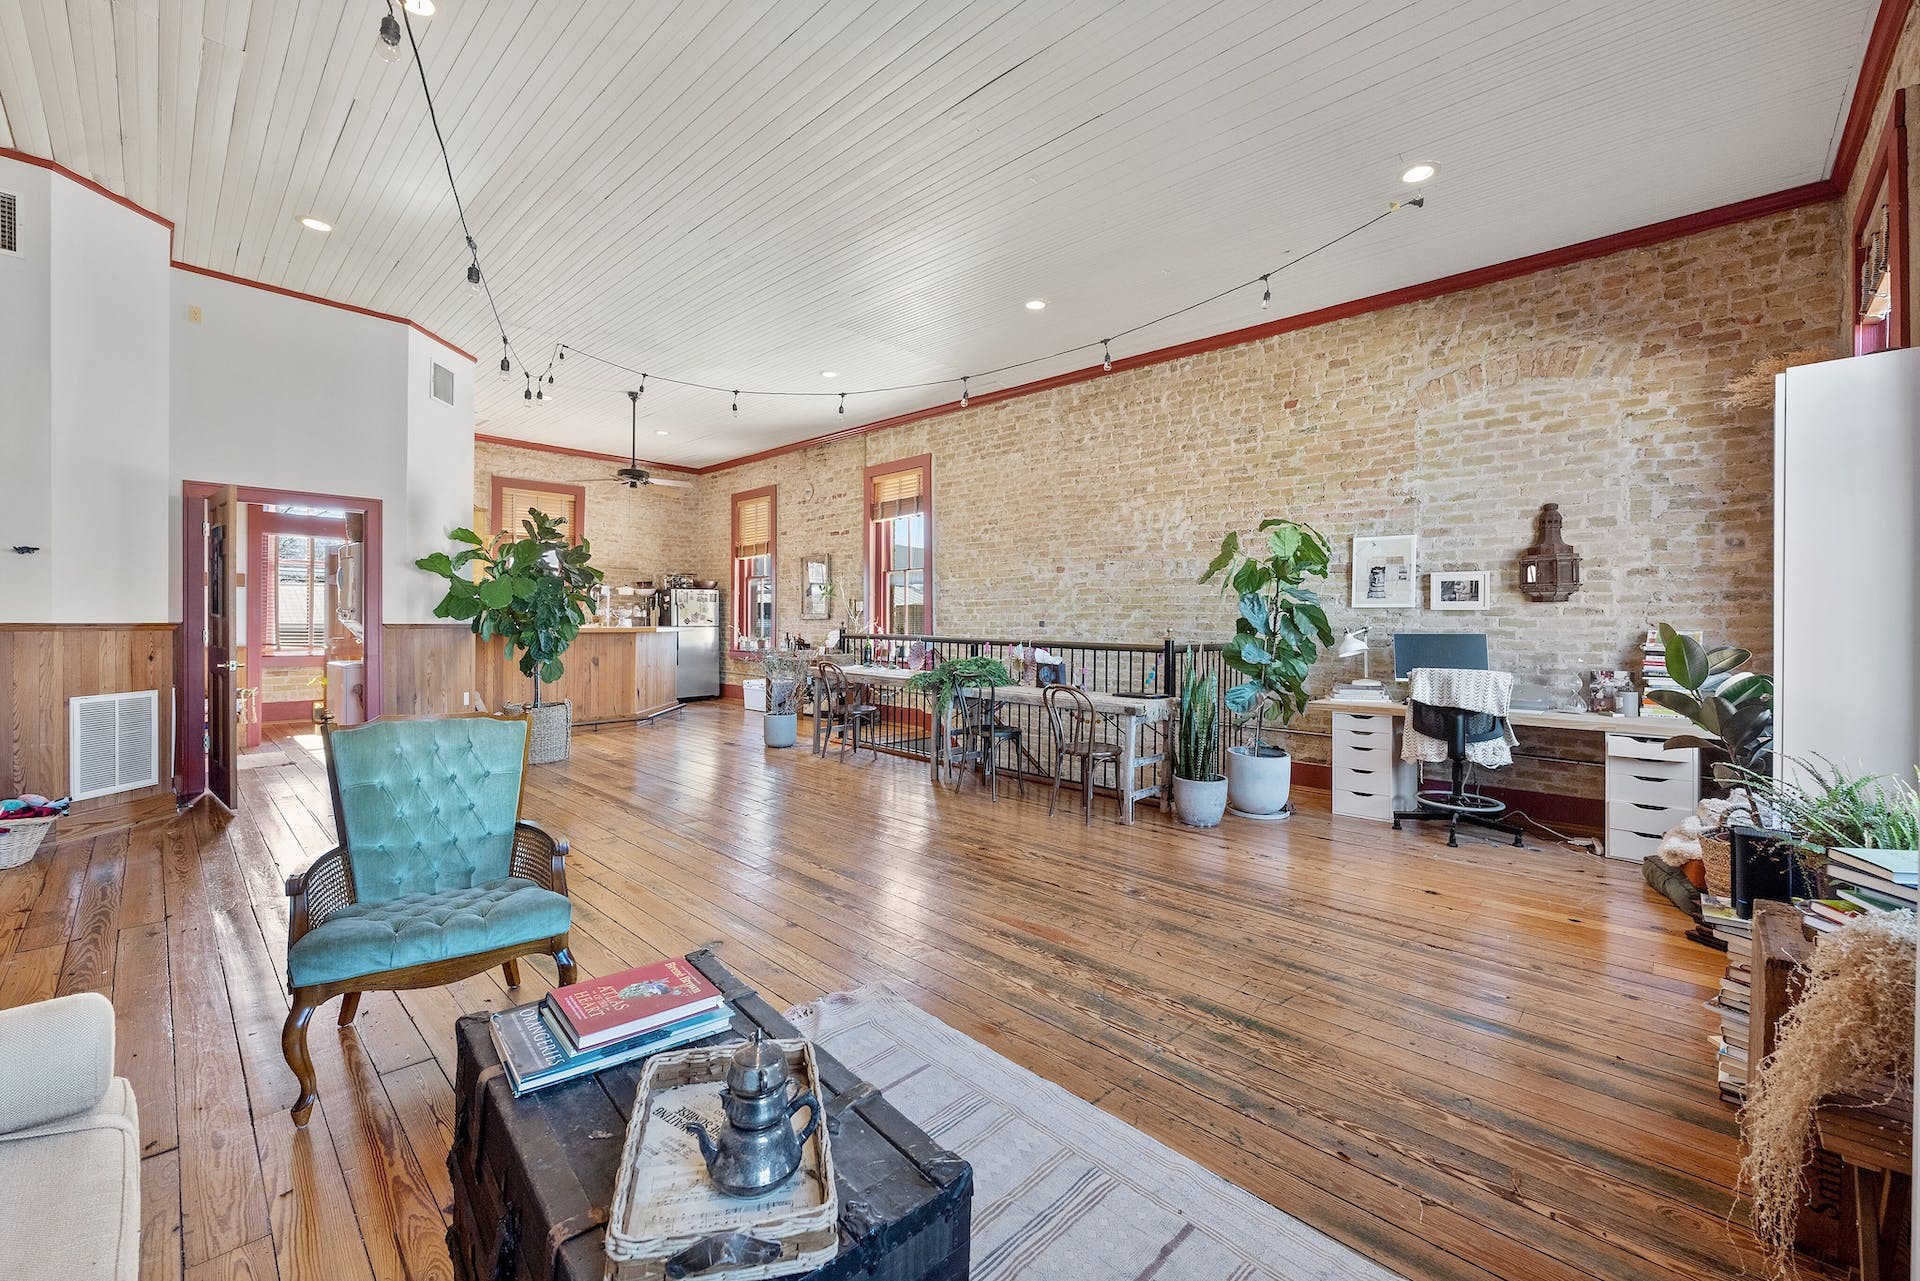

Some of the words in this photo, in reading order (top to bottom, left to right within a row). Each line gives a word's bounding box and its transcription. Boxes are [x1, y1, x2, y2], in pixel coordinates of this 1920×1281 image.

[597, 985, 630, 1011] ATLAS
[680, 975, 702, 994] Brown
[573, 990, 606, 1018] HEART
[519, 1008, 566, 1066] ORANGERIES
